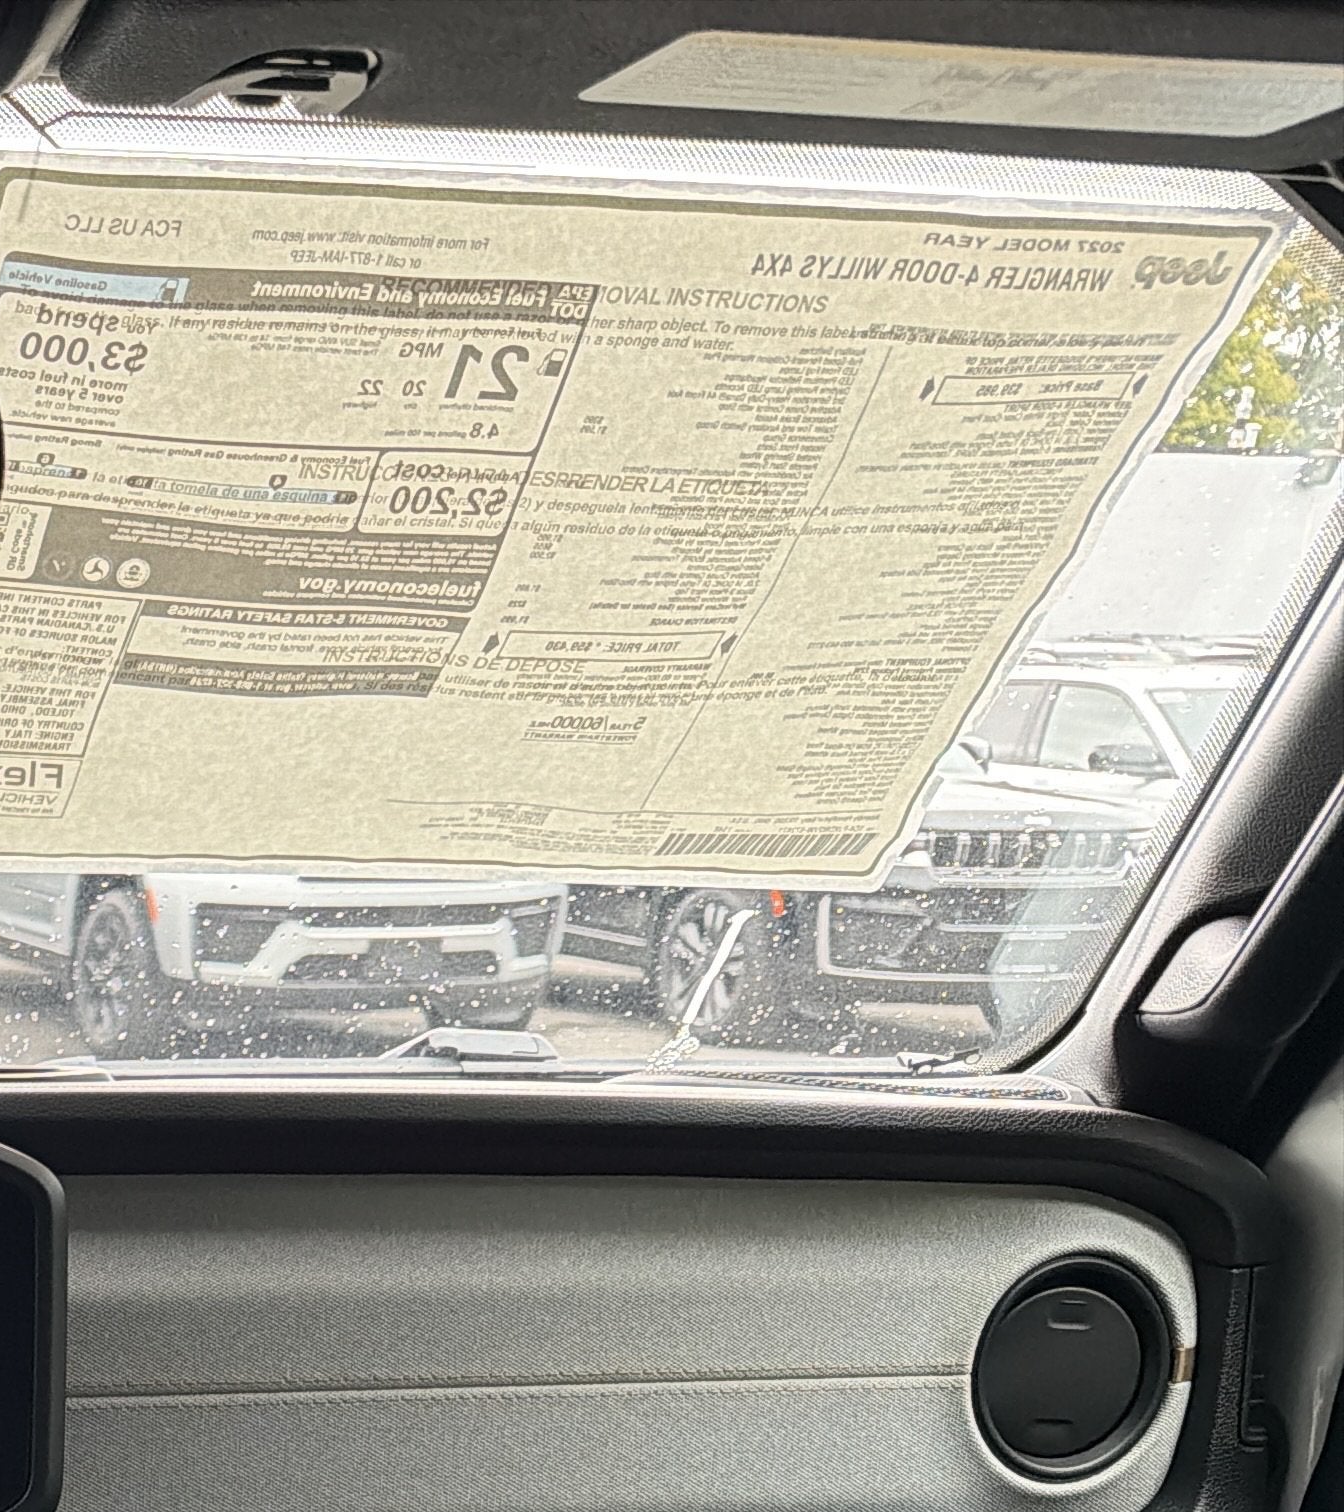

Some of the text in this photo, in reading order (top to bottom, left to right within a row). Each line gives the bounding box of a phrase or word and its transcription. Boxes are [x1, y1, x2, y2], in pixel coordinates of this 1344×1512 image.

[666, 286, 830, 313] INSTRUCTIONS
[616, 318, 656, 332] sharp
[660, 319, 708, 334] object.
[714, 320, 731, 333] To
[734, 325, 789, 338] remove
[792, 325, 817, 338] this
[504, 658, 587, 675] DEPOSE
